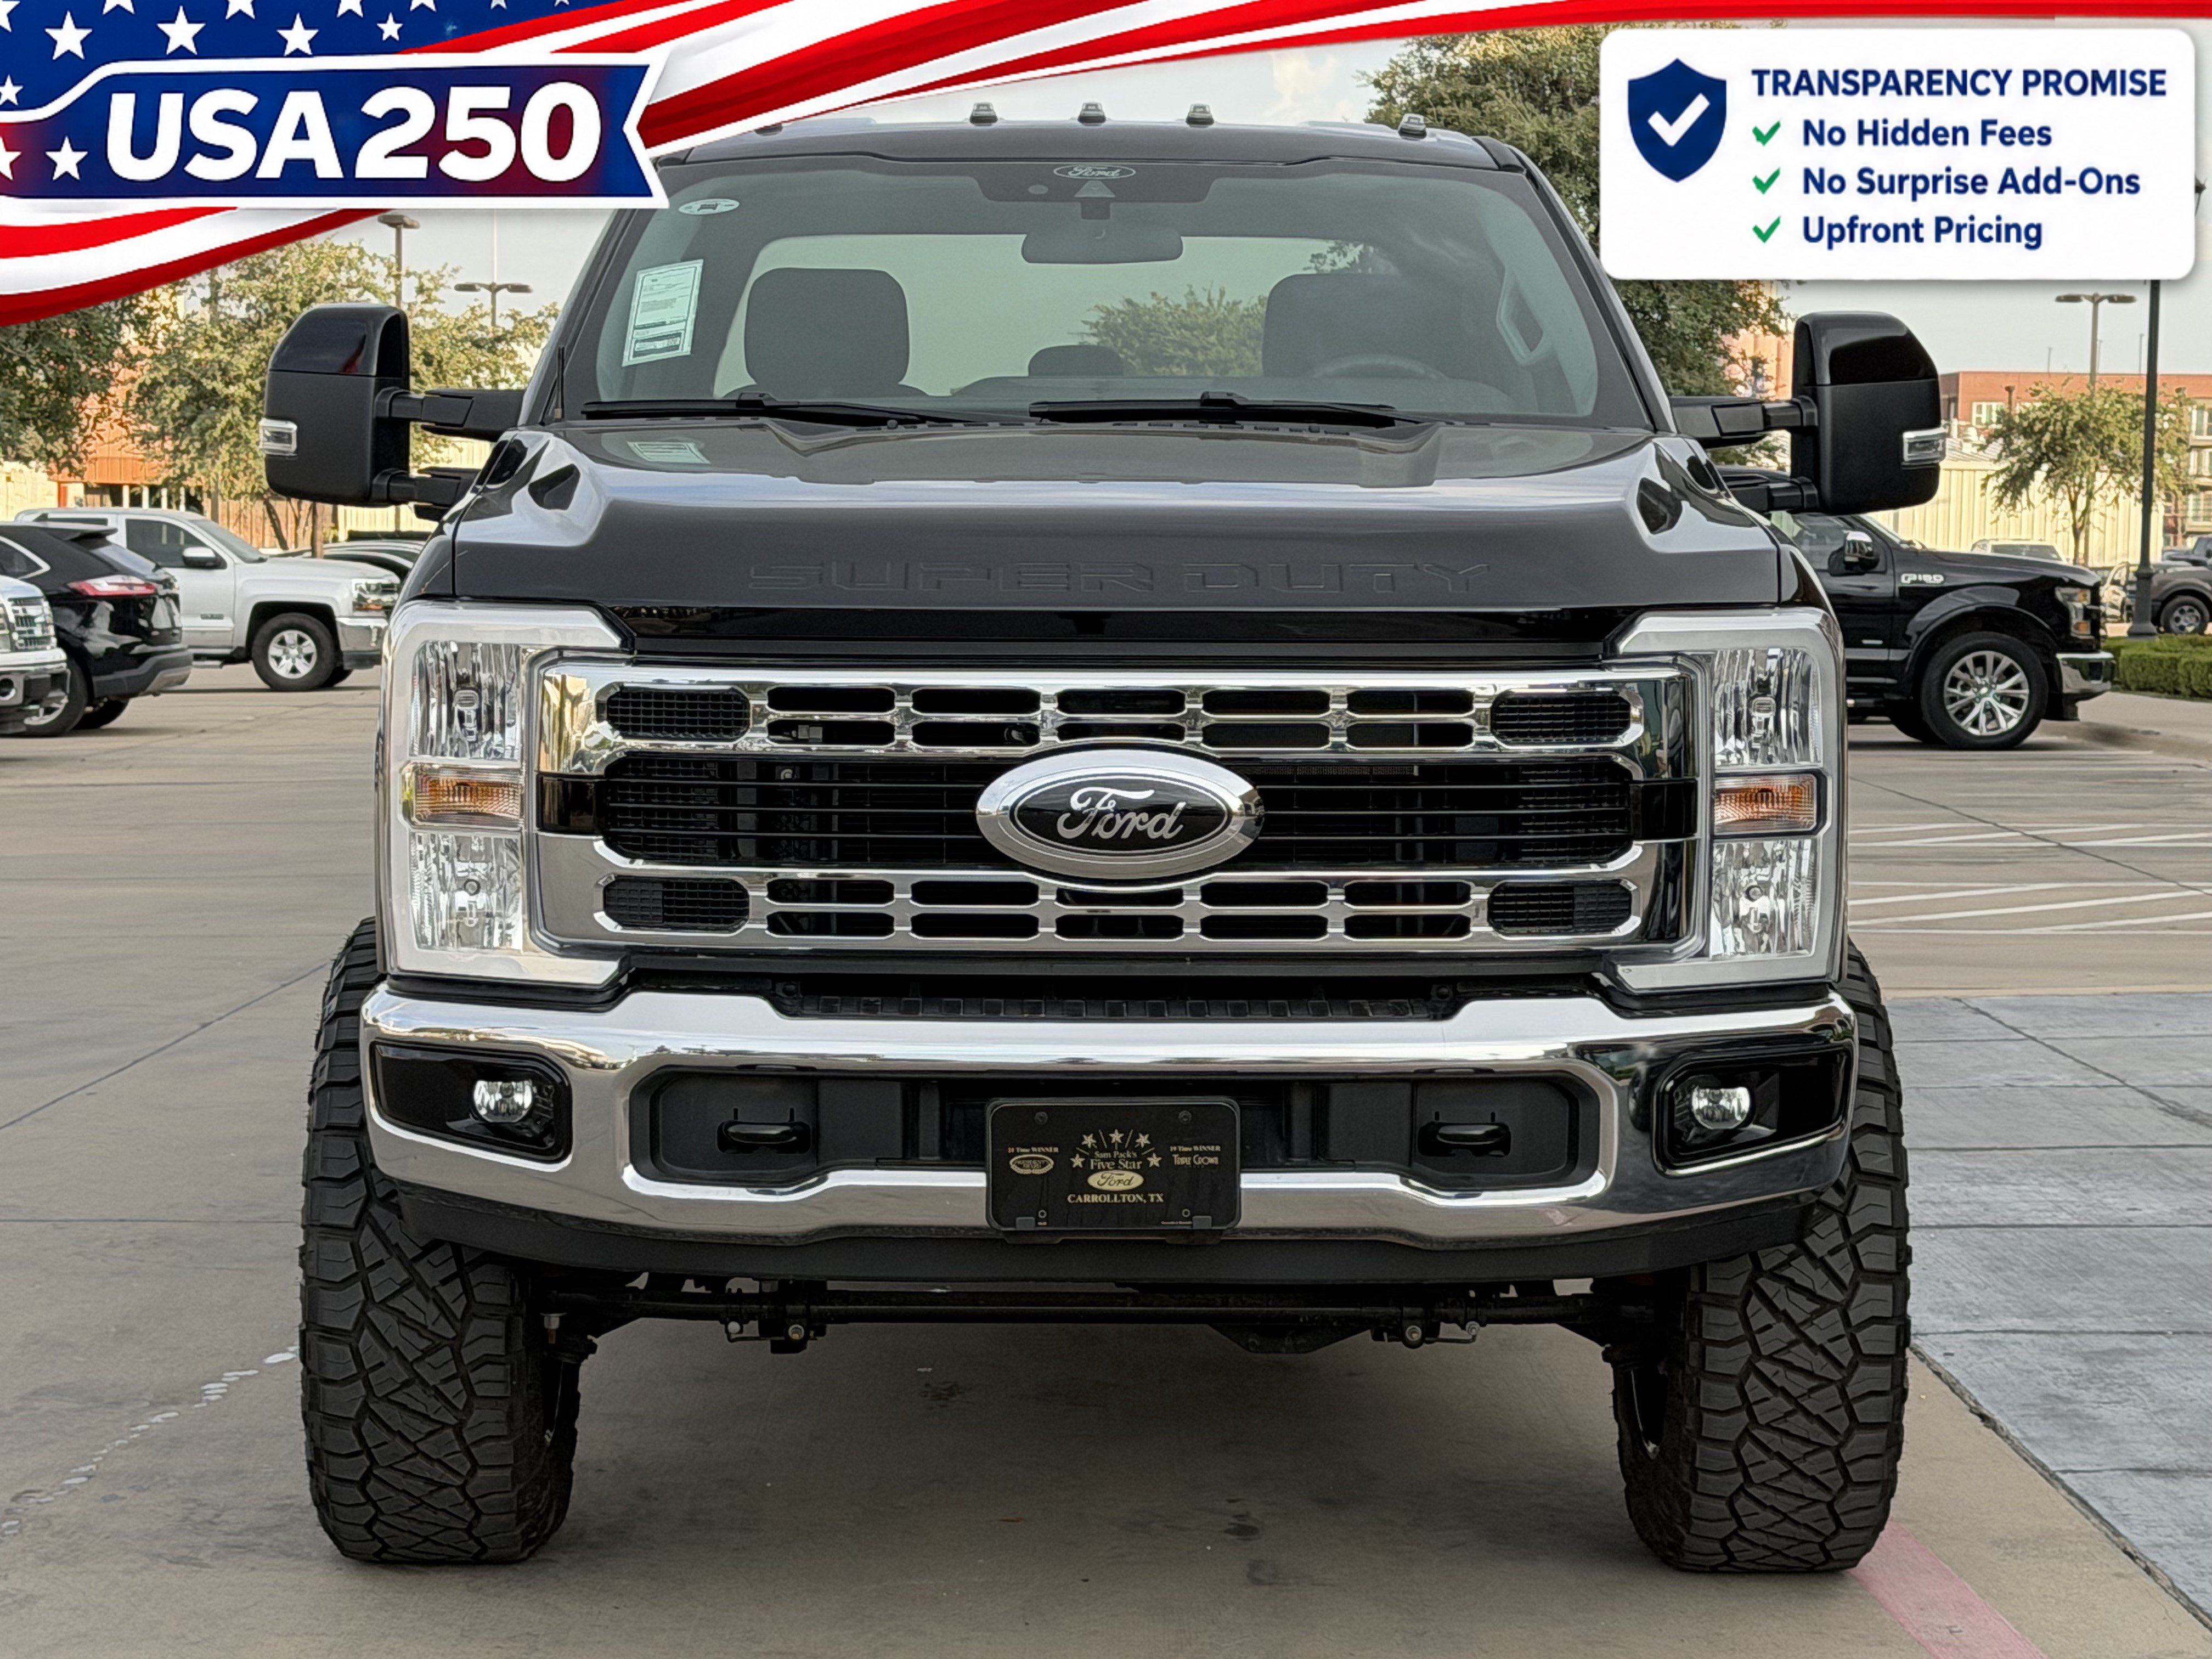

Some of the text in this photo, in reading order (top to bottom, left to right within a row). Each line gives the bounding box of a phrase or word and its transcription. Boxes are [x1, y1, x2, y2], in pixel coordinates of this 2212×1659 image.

[1068, 166, 1122, 177] Ford
[748, 562, 1490, 593] SUPER DUTY
[1057, 786, 1187, 839] Ford
[1113, 1150, 1137, 1159] Pack's
[1090, 1158, 1143, 1170] Five Star
[1097, 1171, 1135, 1187] Ford
[1067, 1193, 1164, 1204] CARROLLTON, TX
